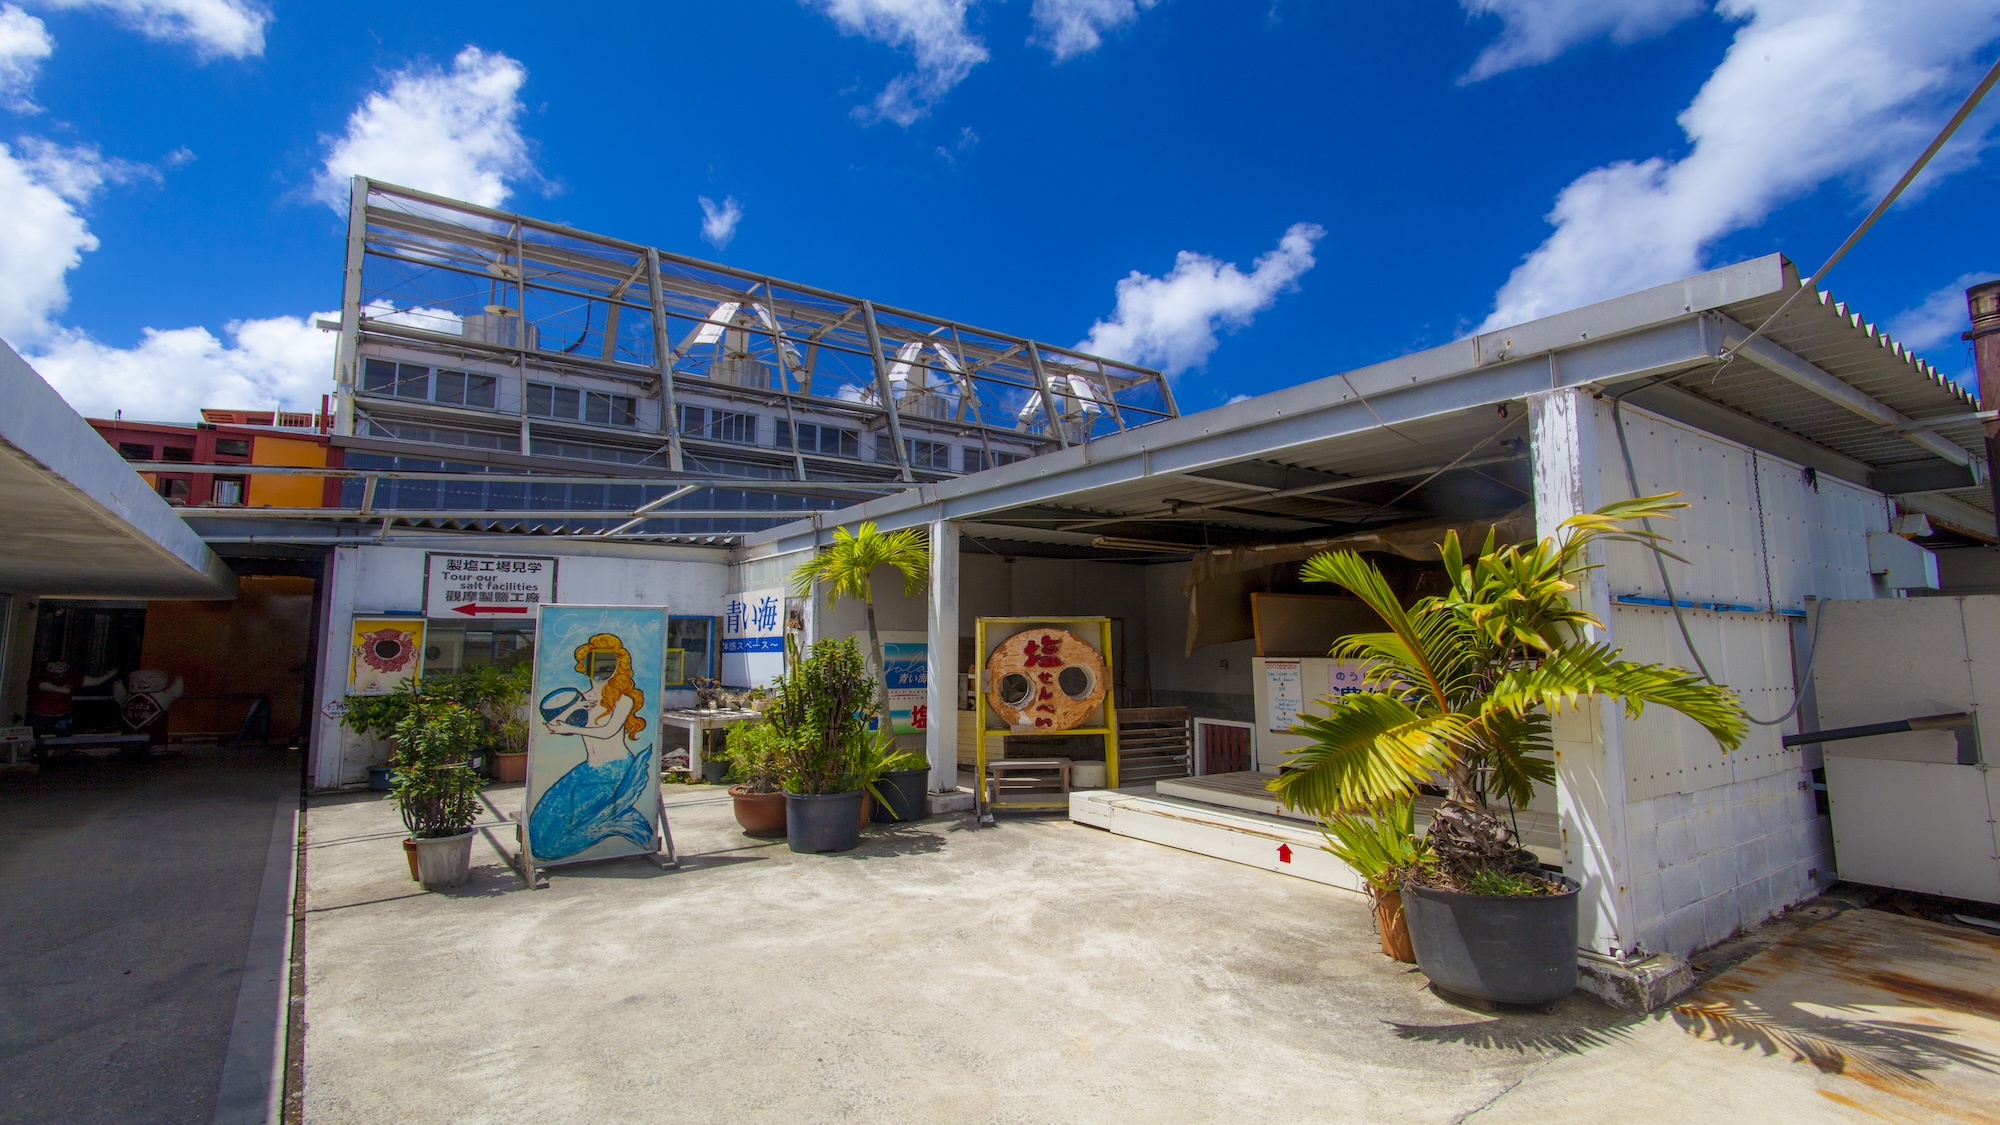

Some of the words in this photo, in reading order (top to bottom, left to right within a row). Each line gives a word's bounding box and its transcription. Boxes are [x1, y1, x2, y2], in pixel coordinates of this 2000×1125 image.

[446, 559, 542, 573] 製塩工場見学
[442, 572, 473, 581] Tour
[476, 574, 498, 582] our
[460, 581, 483, 590] salt
[486, 581, 538, 591] facilities
[445, 590, 540, 603] 觀摩製鹽工廠
[726, 596, 778, 634] 青い海
[629, 617, 662, 637] 青い海
